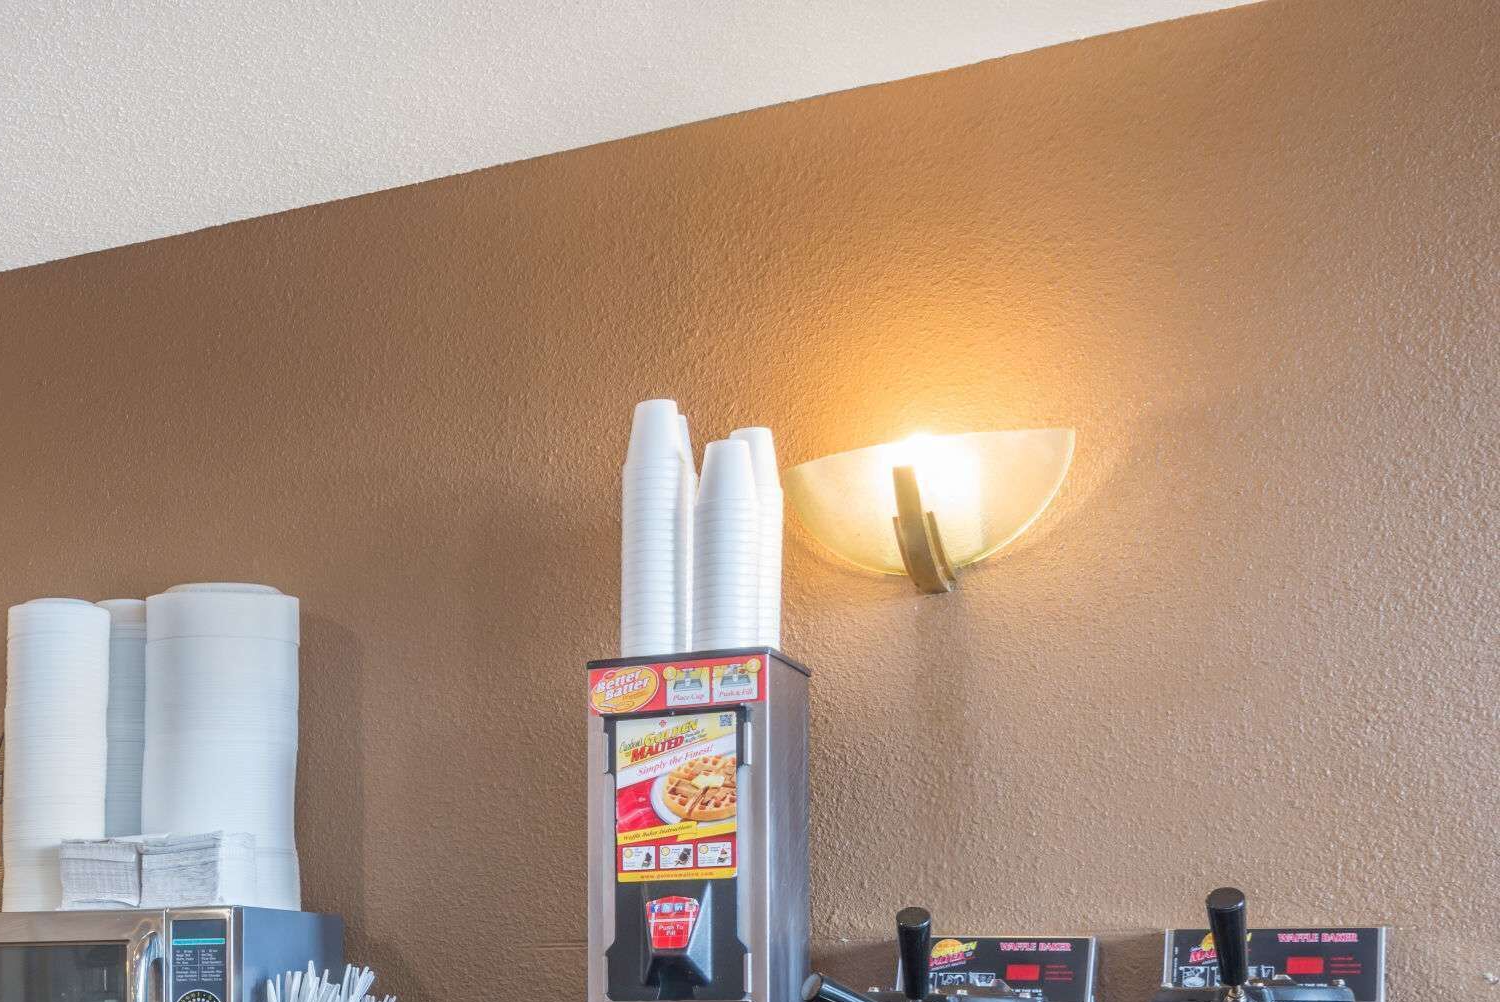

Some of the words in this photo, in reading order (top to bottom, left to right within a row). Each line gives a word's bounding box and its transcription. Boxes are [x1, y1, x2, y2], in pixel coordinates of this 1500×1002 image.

[630, 735, 685, 761] MALTED
[636, 762, 666, 776] Simply
[667, 757, 681, 767] the
[1278, 933, 1318, 943] WAFFLE
[1321, 933, 1358, 943] BAKER
[1000, 942, 1036, 951] WAFFLE
[1039, 942, 1072, 952] BAKER
